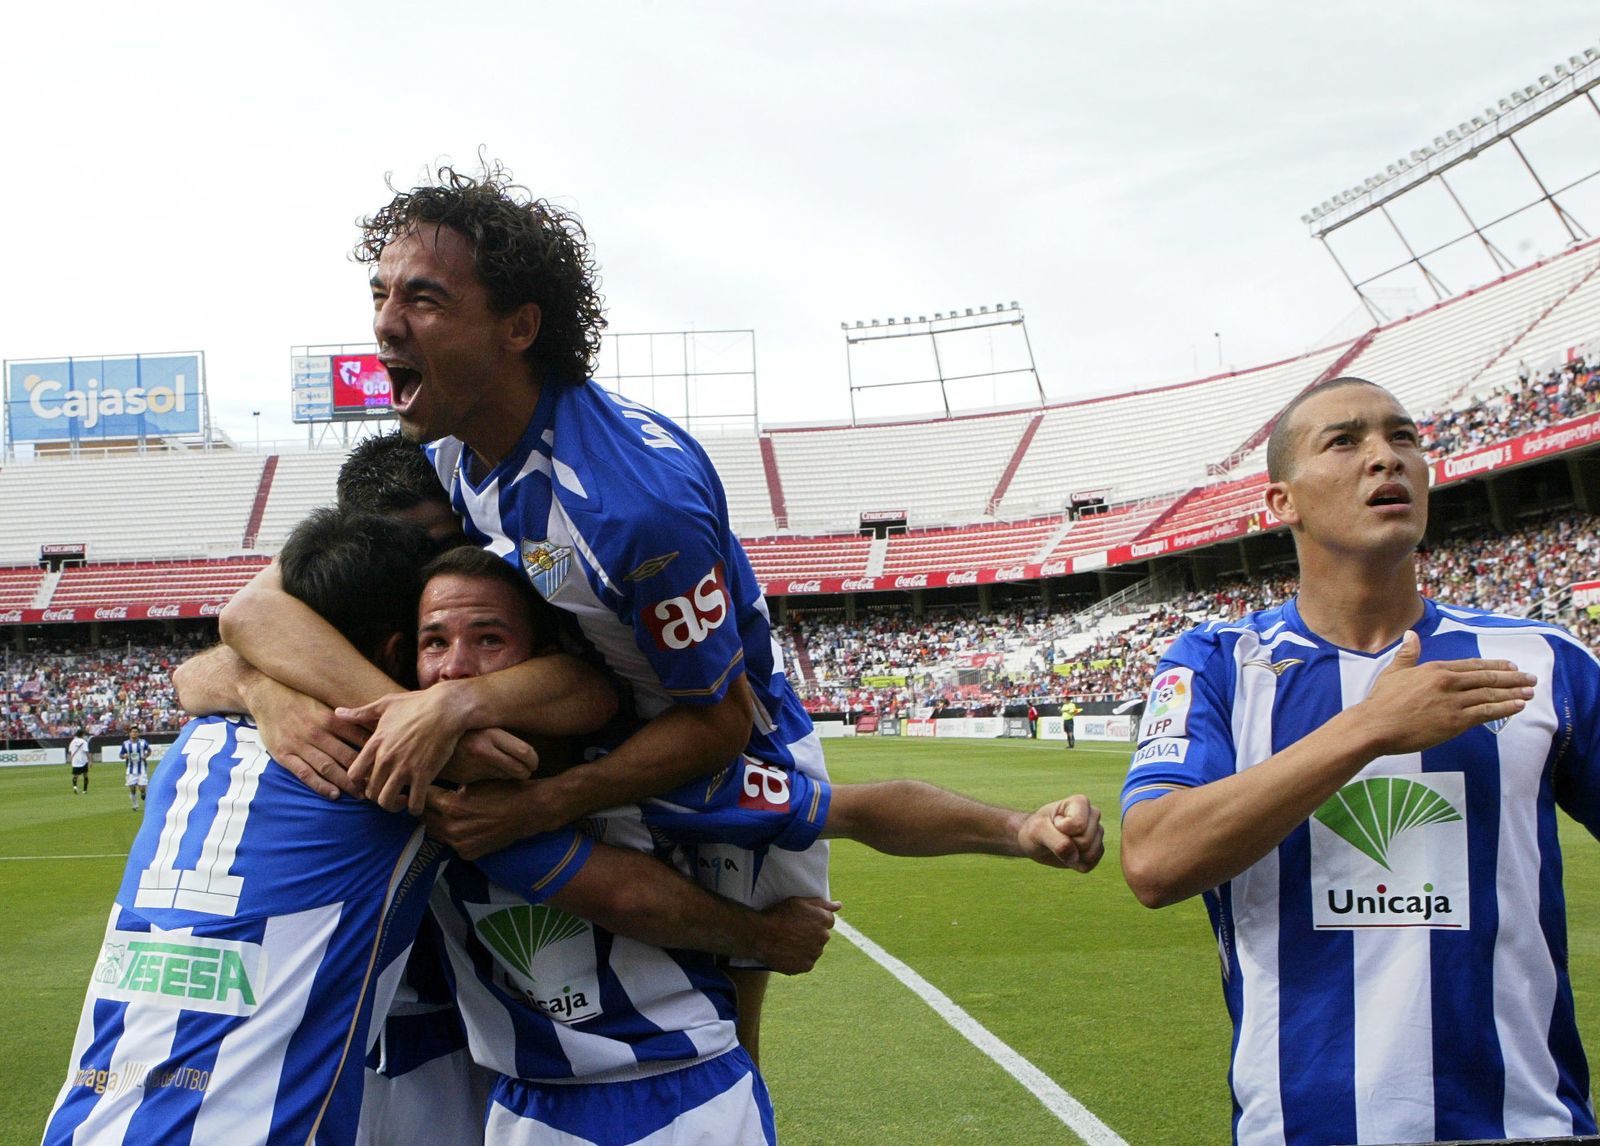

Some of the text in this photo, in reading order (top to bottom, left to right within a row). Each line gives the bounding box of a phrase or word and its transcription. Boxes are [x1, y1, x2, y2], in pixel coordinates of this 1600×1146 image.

[363, 381, 390, 396] 0:0
[30, 374, 186, 428] Cajasol
[1444, 446, 1504, 479] Cruzcampo
[43, 545, 83, 554] Cruzcampo
[788, 580, 822, 593] Coca-Cola
[42, 608, 77, 621] Coca-Cola
[94, 606, 129, 620] Coca-Cola
[147, 604, 180, 617] Coca-Cola
[655, 566, 727, 650] as
[1146, 718, 1173, 737] LFP
[133, 721, 272, 917] 11
[1328, 882, 1453, 920] Unicaja
[504, 972, 589, 1017] Uicaja
